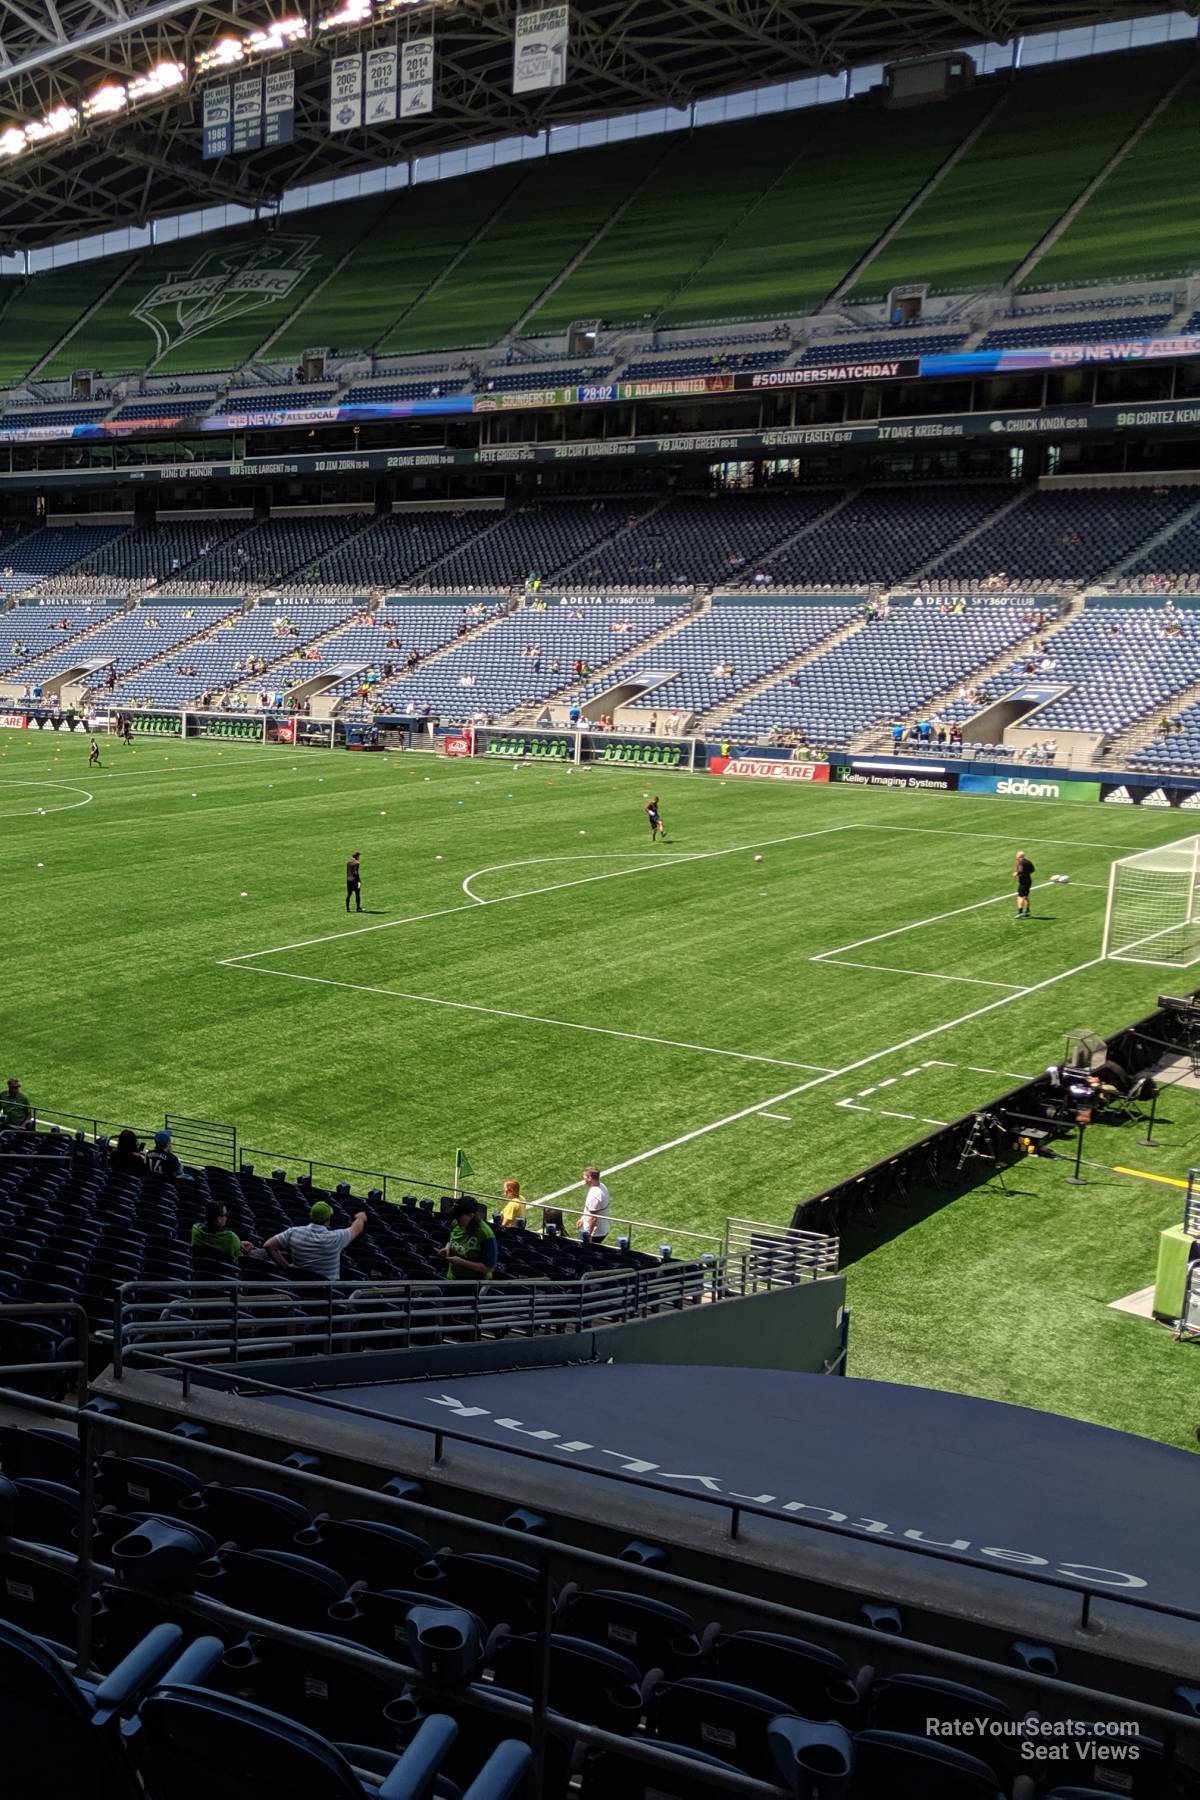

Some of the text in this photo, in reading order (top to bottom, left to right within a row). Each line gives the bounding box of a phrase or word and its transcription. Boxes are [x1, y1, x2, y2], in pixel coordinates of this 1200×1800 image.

[406, 57, 428, 71] 2014
[370, 64, 392, 78] 2013
[409, 69, 425, 80] NFC
[336, 72, 357, 86] 2005
[374, 77, 389, 88] NFC
[339, 84, 354, 95] NFC
[207, 127, 227, 140] 1988
[208, 141, 227, 154] 1999
[151, 278, 262, 304] SOUNDERS
[264, 279, 288, 290] FC
[1085, 342, 1144, 360] NEWS
[752, 363, 899, 386] #SOUNDERSMATCHDAY
[501, 391, 543, 407] SOUNDERS
[544, 389, 556, 404] FC
[564, 389, 571, 403] 0
[582, 385, 613, 401] 28:02
[625, 384, 632, 398] 0
[635, 382, 673, 396] ATLANTA
[674, 379, 706, 393] UNITED
[248, 412, 284, 425] NEWS
[304, 411, 334, 420] LOCAL
[1117, 412, 1136, 426] 96
[1136, 411, 1175, 425] CORTEZ
[878, 424, 943, 439] 17 DAVE KRIEG
[1006, 418, 1066, 432] CHUCK KNOX
[657, 438, 720, 451] 79 JACOB GREEN
[762, 432, 834, 445] 45 KENNY EASLEY
[479, 450, 519, 462] PETE GROSS
[567, 446, 587, 456] CURT
[315, 461, 325, 471] 10
[338, 460, 355, 470] ZORN
[386, 454, 440, 467] 22 DAVE BROWN
[160, 467, 212, 479] RING OF HONOR
[240, 465, 258, 475] STEVE
[259, 464, 285, 474] LARGENT
[570, 596, 602, 605] DELTA
[926, 597, 967, 606] DELTA
[725, 760, 814, 779] ADVOCARE
[843, 774, 948, 789] Kelley Imaging Systems
[996, 778, 1060, 798] slalom
[149, 1158, 165, 1175] 14
